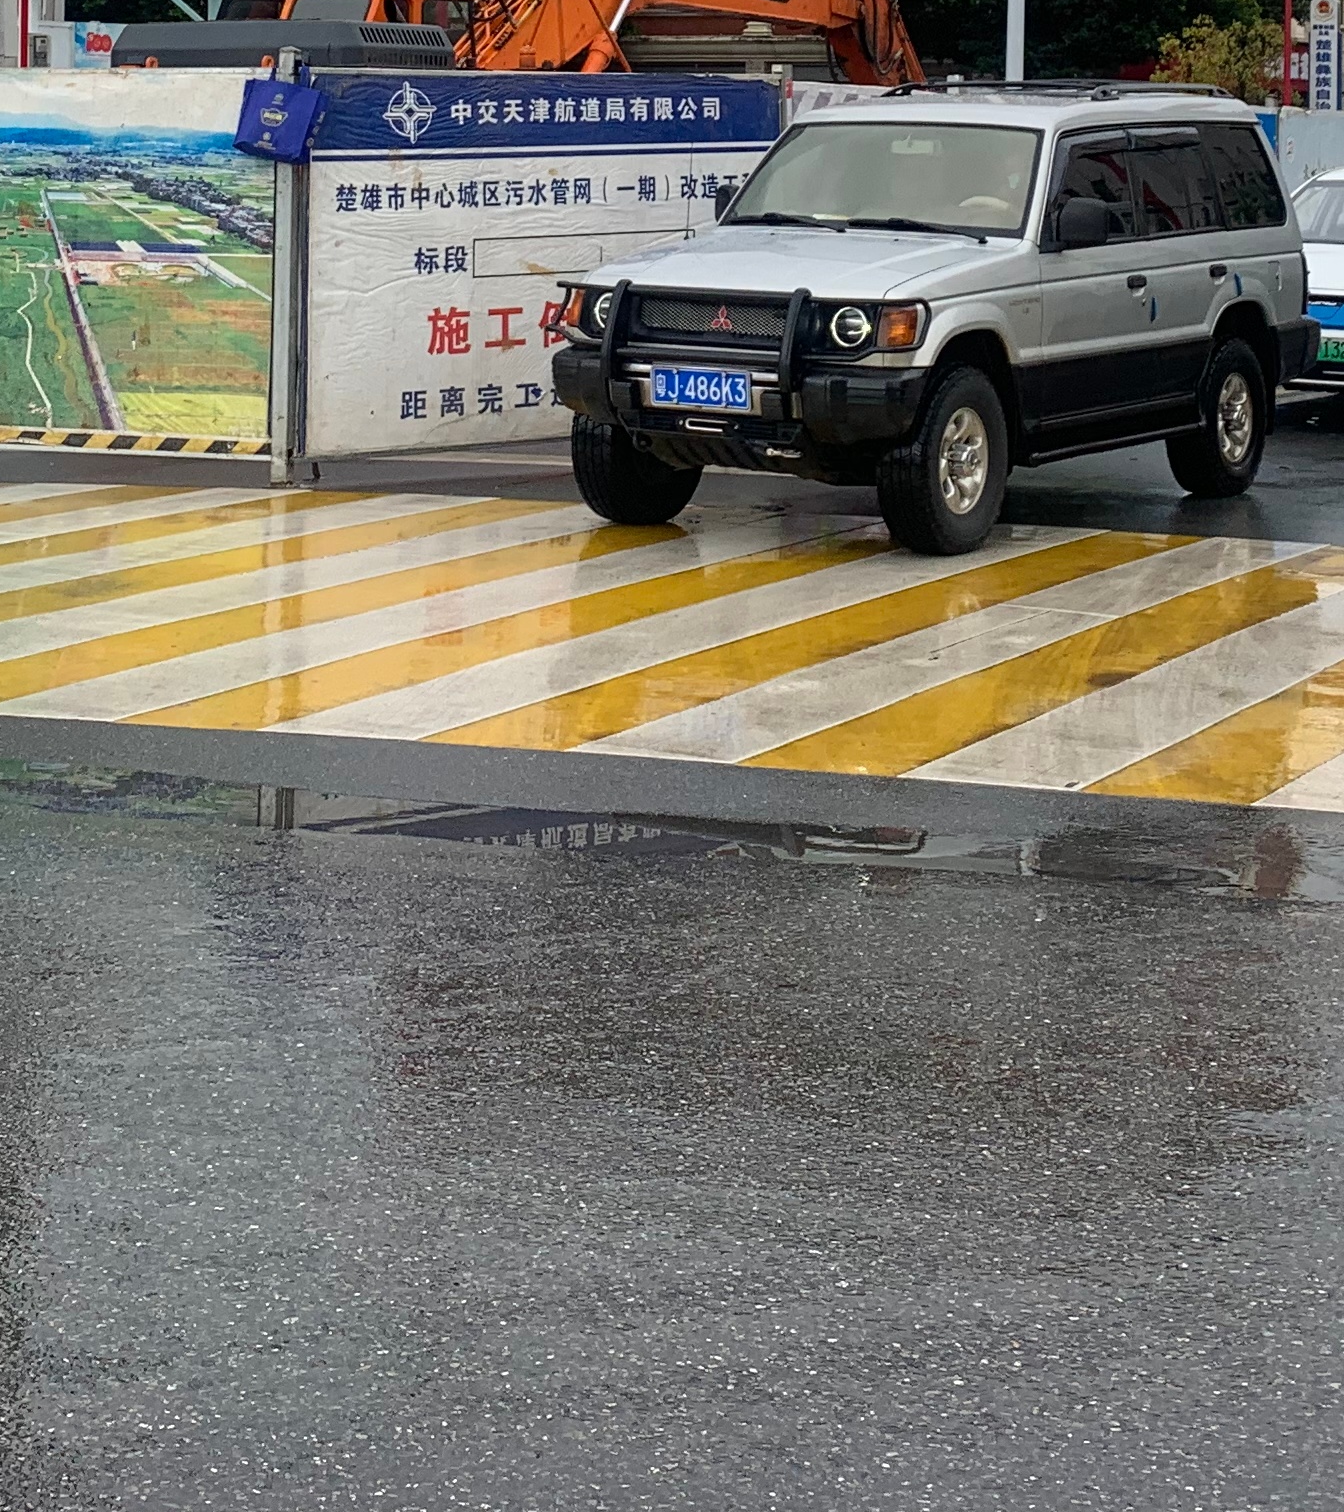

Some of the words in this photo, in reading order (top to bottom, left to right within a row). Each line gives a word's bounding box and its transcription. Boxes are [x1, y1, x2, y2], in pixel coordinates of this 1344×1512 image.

[449, 96, 723, 126] 中交天津航道局有限公司
[414, 245, 469, 275] 标段
[400, 381, 566, 420] 距离完工
